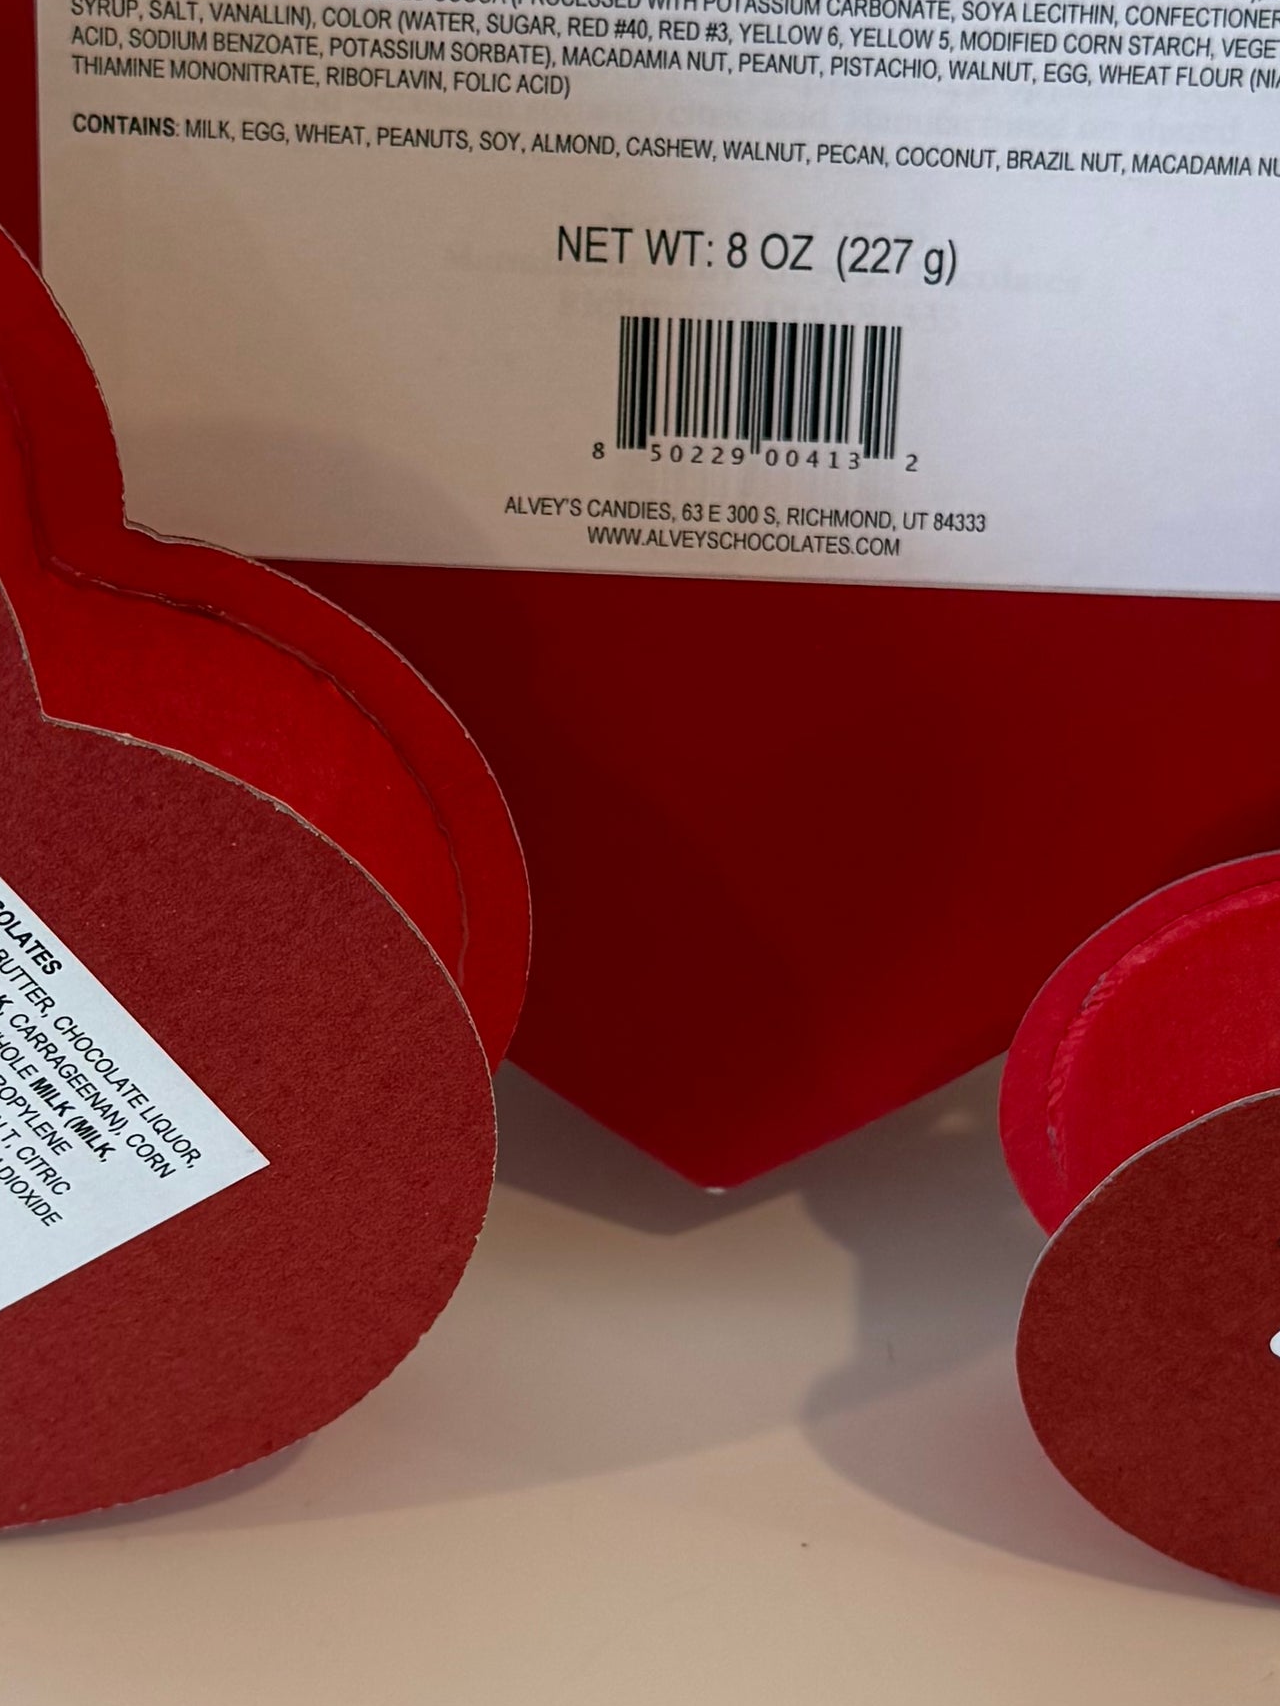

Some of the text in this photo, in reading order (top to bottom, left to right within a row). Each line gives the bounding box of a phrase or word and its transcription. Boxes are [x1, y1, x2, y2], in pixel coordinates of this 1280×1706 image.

[72, 112, 180, 137] CONTAINS:
[184, 118, 235, 143] MILK,
[241, 120, 290, 145] EGG,
[294, 122, 371, 148] WHEAT,
[376, 125, 473, 153] PEANUTS,
[478, 129, 526, 154] SOY,
[530, 132, 621, 158] ALMOND,
[625, 135, 717, 162] CASHEW,
[722, 139, 811, 165] WALNUT,
[816, 143, 889, 168] PECAN,
[895, 145, 1000, 172] COCONUT,
[1006, 149, 1075, 171] BRAZIL
[1080, 151, 1126, 176] NUT,
[1131, 153, 1252, 177] MACADAMIA
[557, 224, 634, 264] NET
[644, 228, 713, 268] WT:
[726, 230, 748, 269] 8
[760, 232, 814, 271] OZ
[836, 235, 914, 283] (227
[923, 238, 957, 286] g)
[504, 495, 986, 533] ALVEY'S CANDIES, 63 E 300 S, RICHMOND, UT 84333
[586, 525, 901, 556] WWW.ALVEYSCHOCOLATES.COM
[8, 1013, 129, 1136] CARRAGEENAN),
[124, 1133, 176, 1179] CORN
[52, 1015, 150, 1110] CHOCOLATE
[138, 1104, 202, 1169] LIQUOR,
